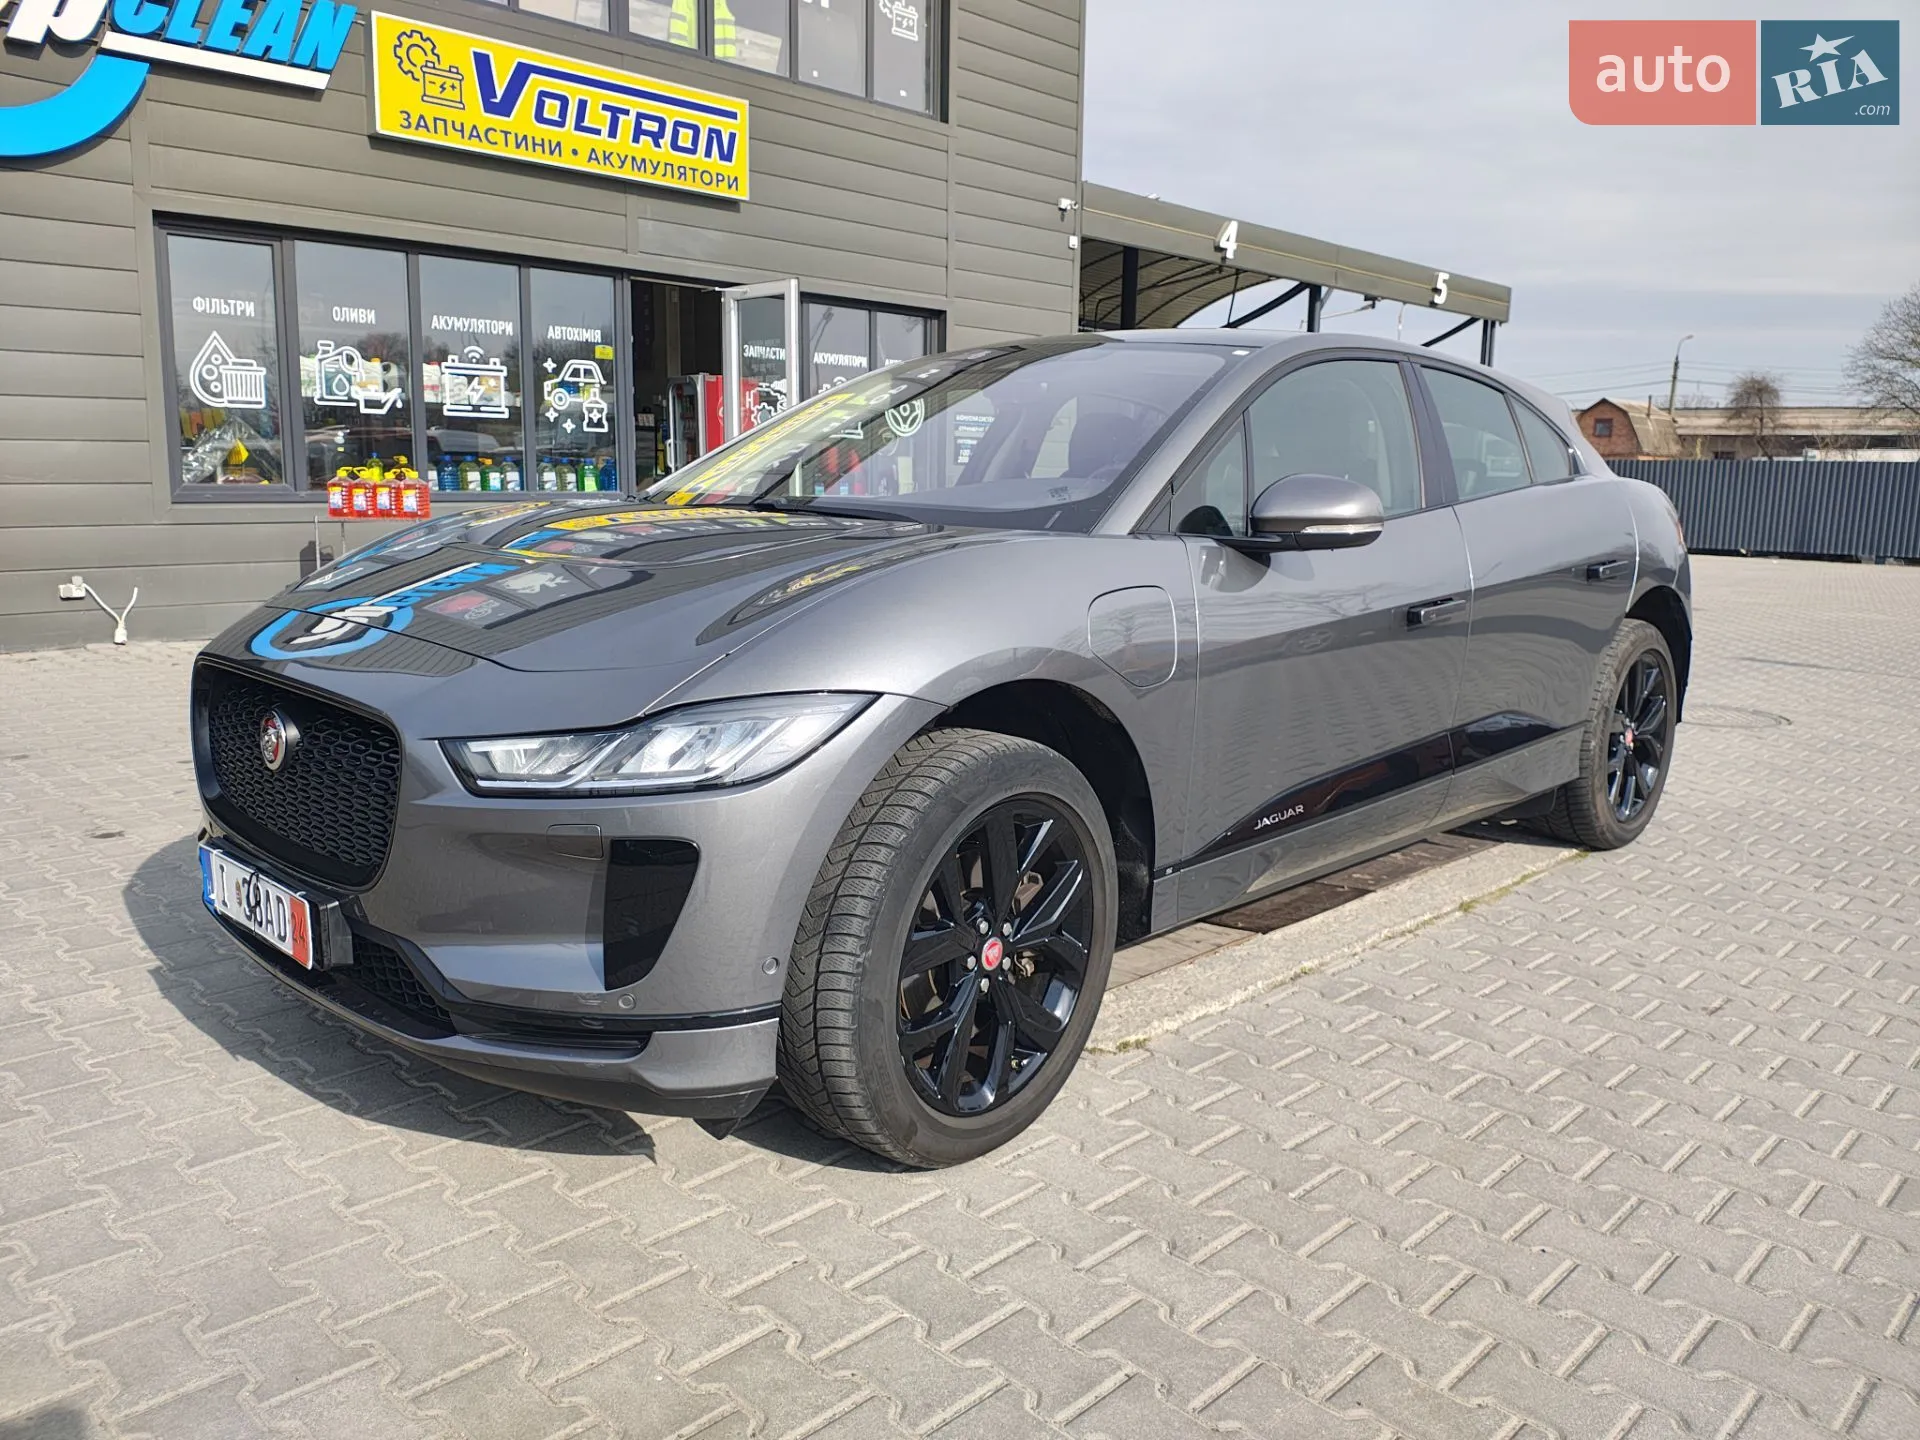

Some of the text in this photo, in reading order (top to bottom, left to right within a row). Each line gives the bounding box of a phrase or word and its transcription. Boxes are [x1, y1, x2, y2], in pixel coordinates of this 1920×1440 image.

[472, 50, 738, 164] VOLTRON
[399, 110, 740, 192] ЗАПЧАСТИНИ АКУМУЛЯТОРИ
[1219, 221, 1238, 259] 4
[1433, 272, 1449, 304] 5
[192, 296, 255, 318] ФІЛЬТРИ
[332, 306, 376, 325] ОЛИВИ
[431, 314, 514, 337] АКУМУЛЯТОРИ
[547, 325, 602, 344] АВТОХІМІЯ
[813, 352, 868, 368] АКУМУЛЯТОРИ
[1253, 804, 1305, 831] JAGUAR
